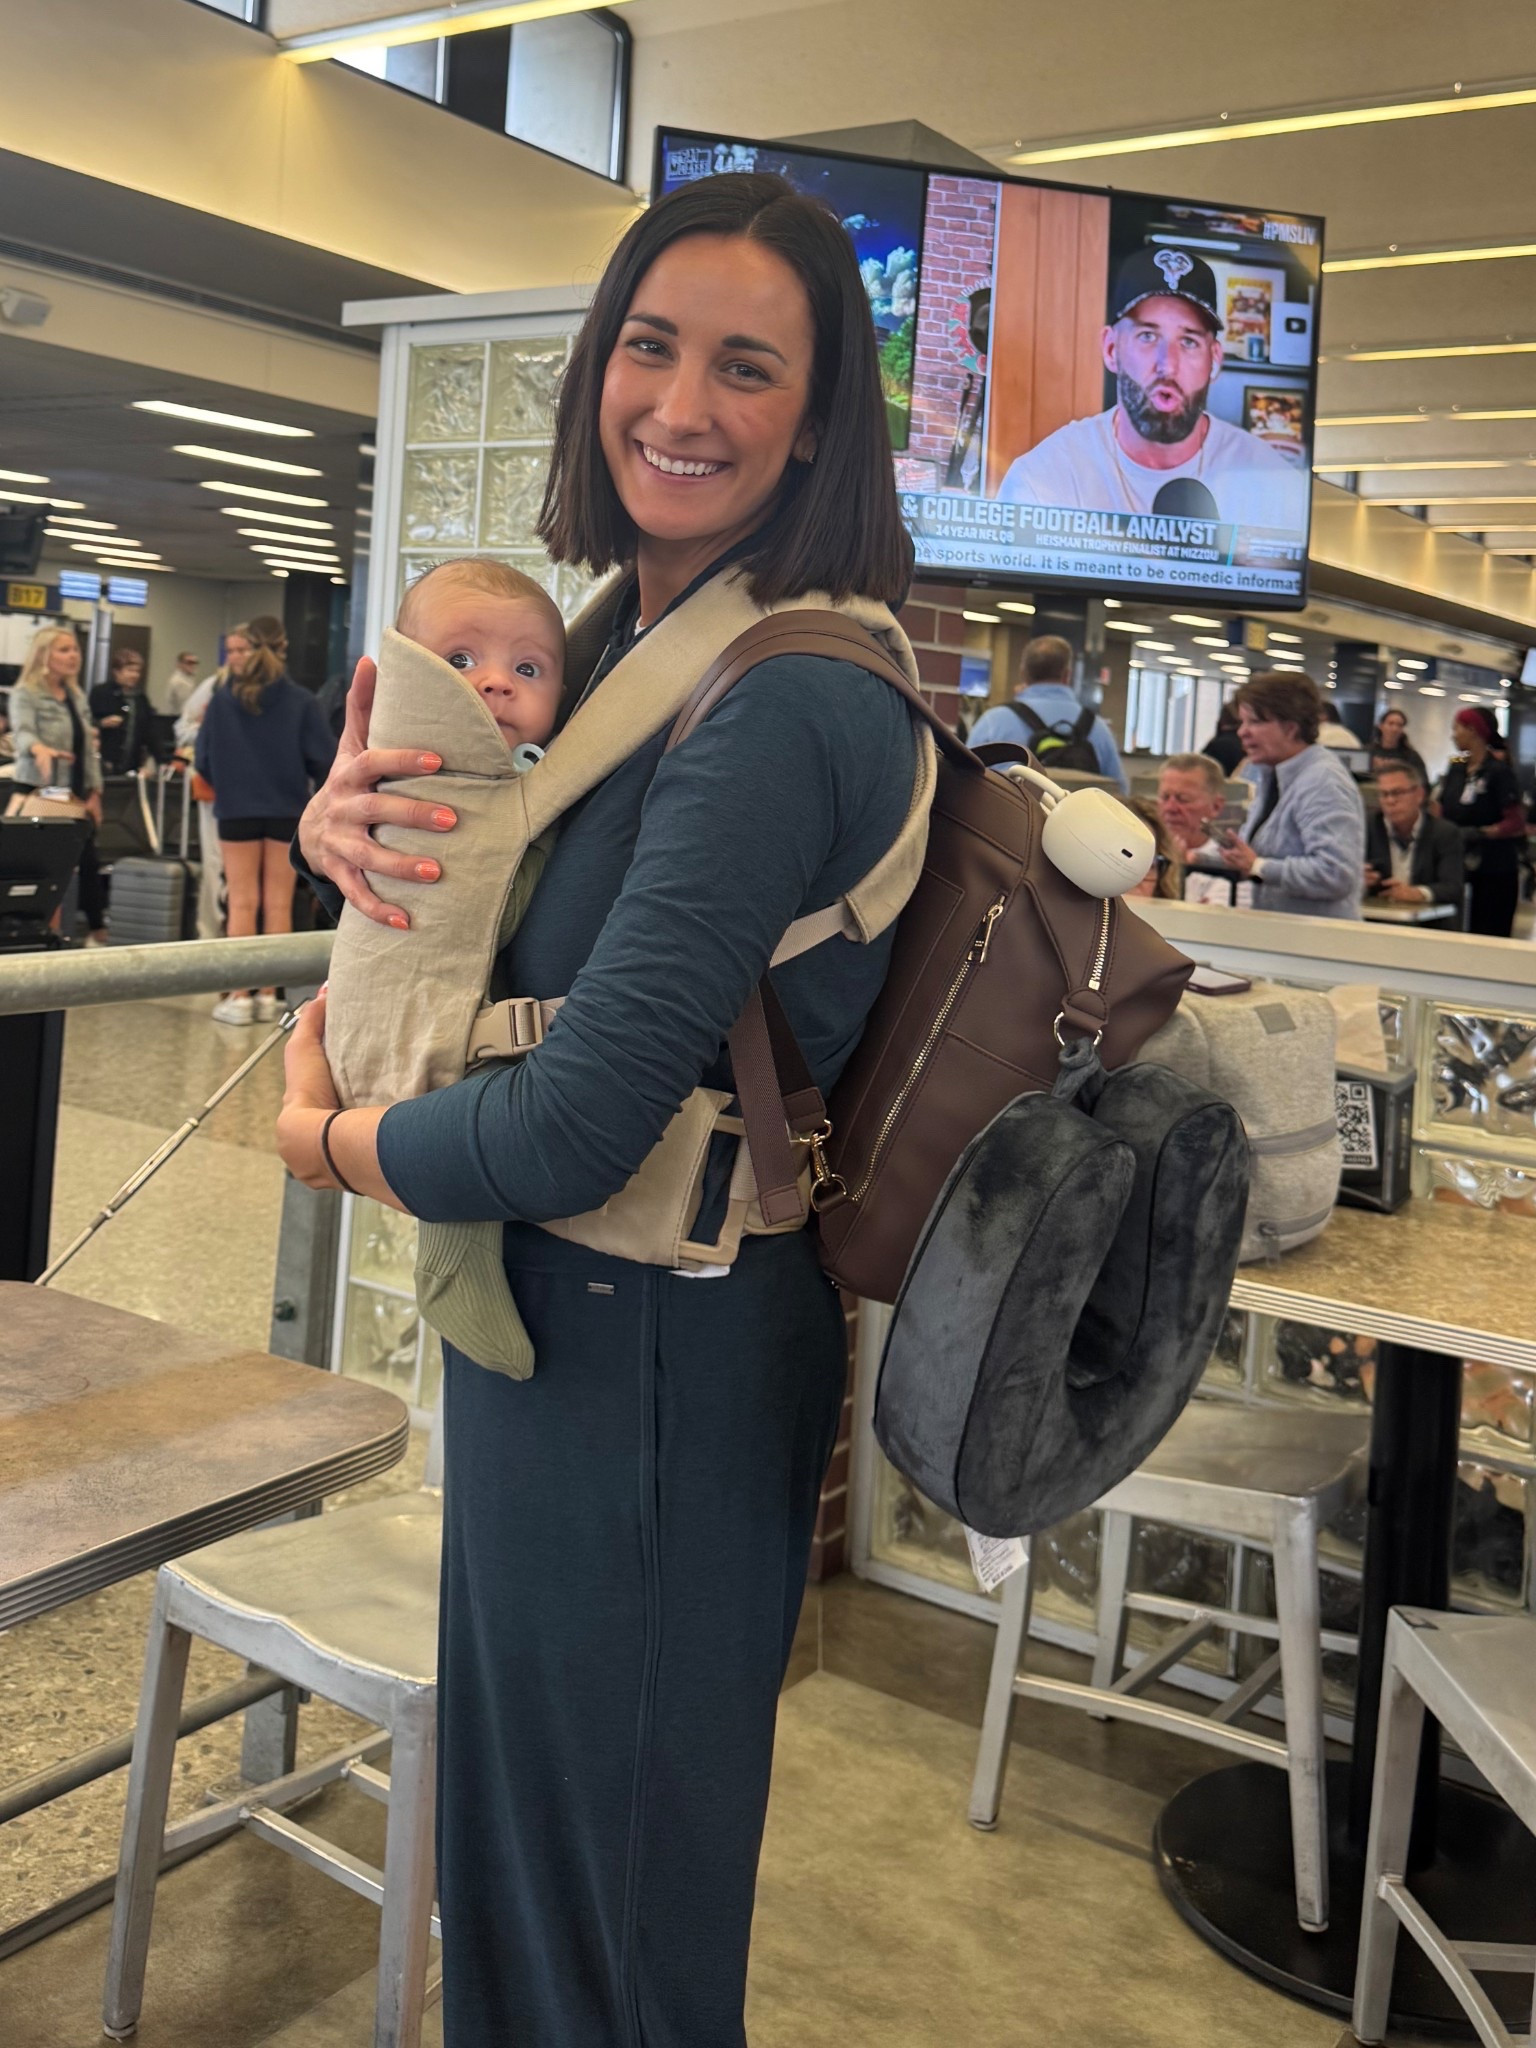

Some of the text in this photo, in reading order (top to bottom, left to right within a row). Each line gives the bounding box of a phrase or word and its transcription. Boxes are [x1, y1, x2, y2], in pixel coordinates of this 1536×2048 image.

[922, 496, 1016, 527] COLLEGE
[1019, 506, 1124, 538] FOOTBALL
[1127, 515, 1217, 546] ANALYST
[950, 525, 977, 539] YEAR
[979, 528, 998, 541] NFL
[1036, 534, 1081, 549] HEISMAN
[1083, 537, 1122, 553] TROPHY
[1123, 541, 1168, 556] FINALIST
[935, 547, 985, 564] sports
[991, 552, 1036, 568] world.
[1057, 556, 1070, 571] is
[1074, 560, 1122, 576] meant
[1127, 564, 1142, 578] to
[1147, 564, 1165, 580] be
[1169, 569, 1233, 585] comedic
